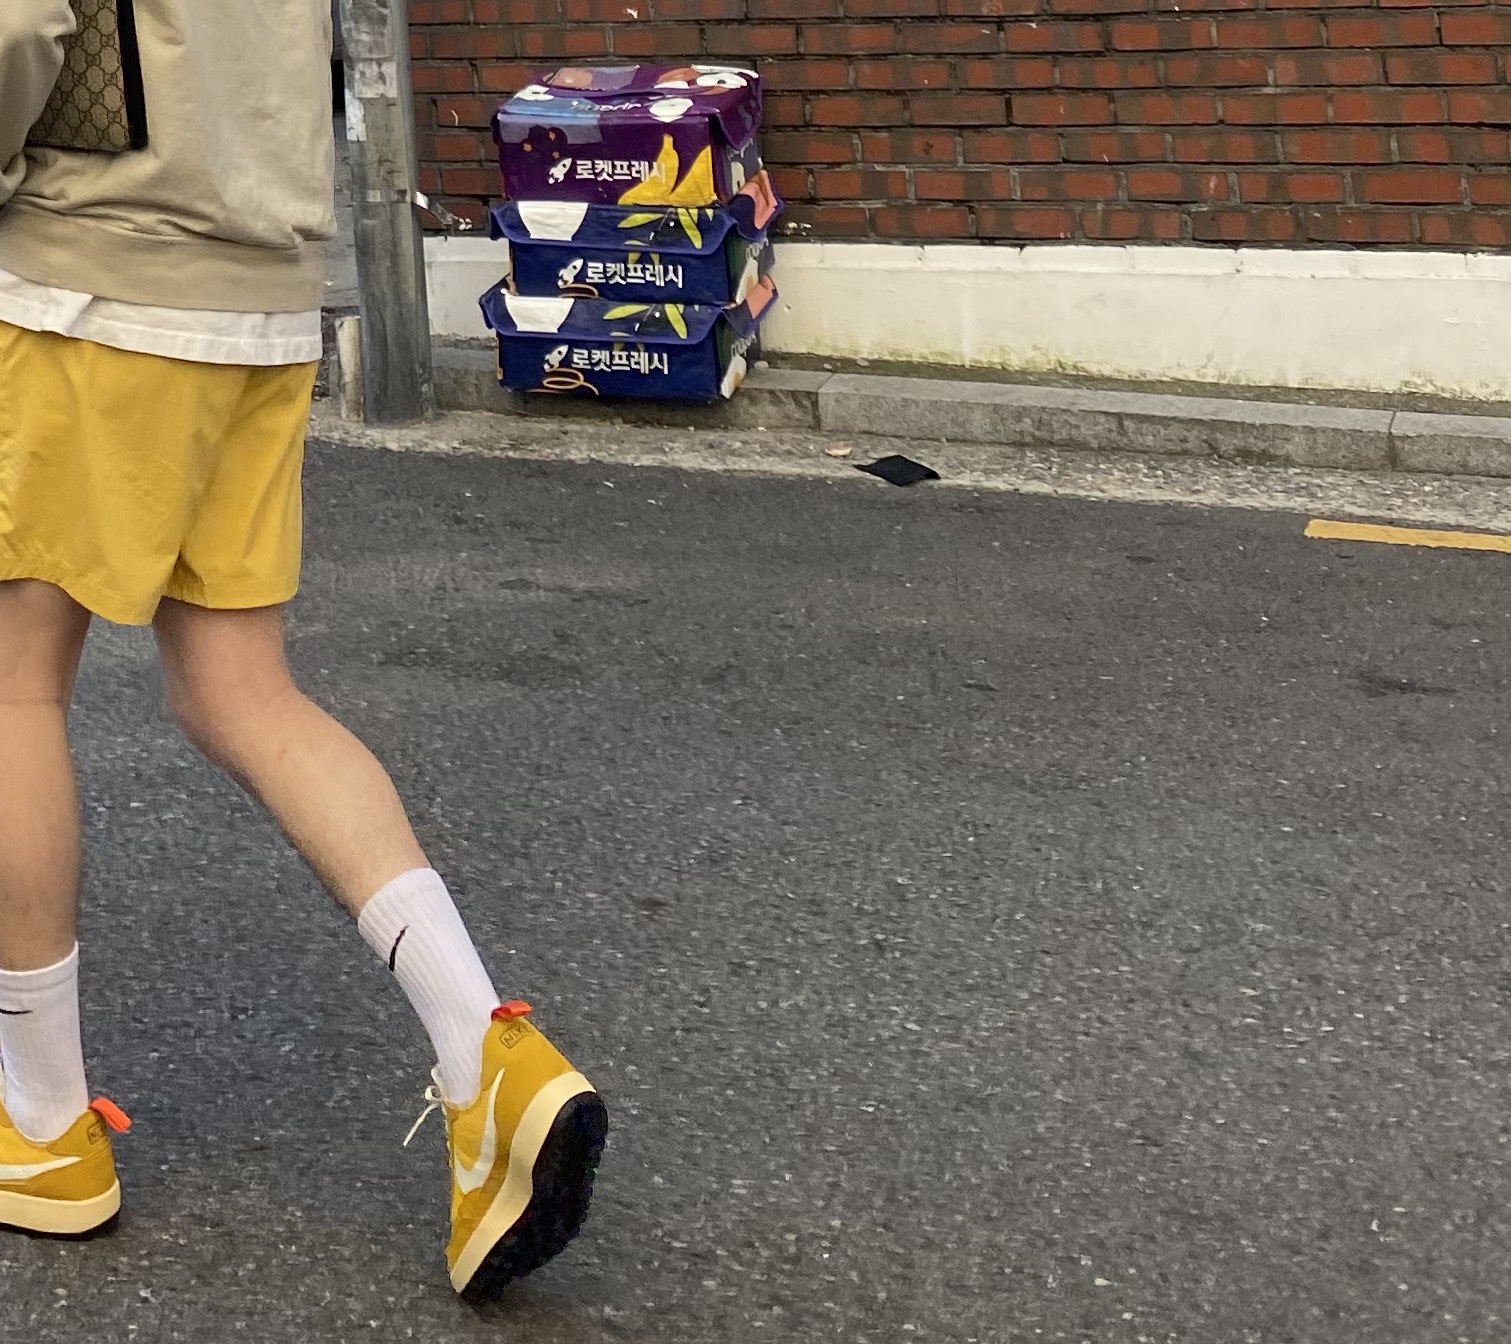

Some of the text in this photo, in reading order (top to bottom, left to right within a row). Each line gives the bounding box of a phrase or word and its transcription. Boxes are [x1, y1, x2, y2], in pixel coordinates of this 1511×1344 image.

[575, 159, 666, 183] 로켓프레시
[585, 261, 683, 289] 로켓프레시
[571, 348, 669, 375] 로켓프레시
